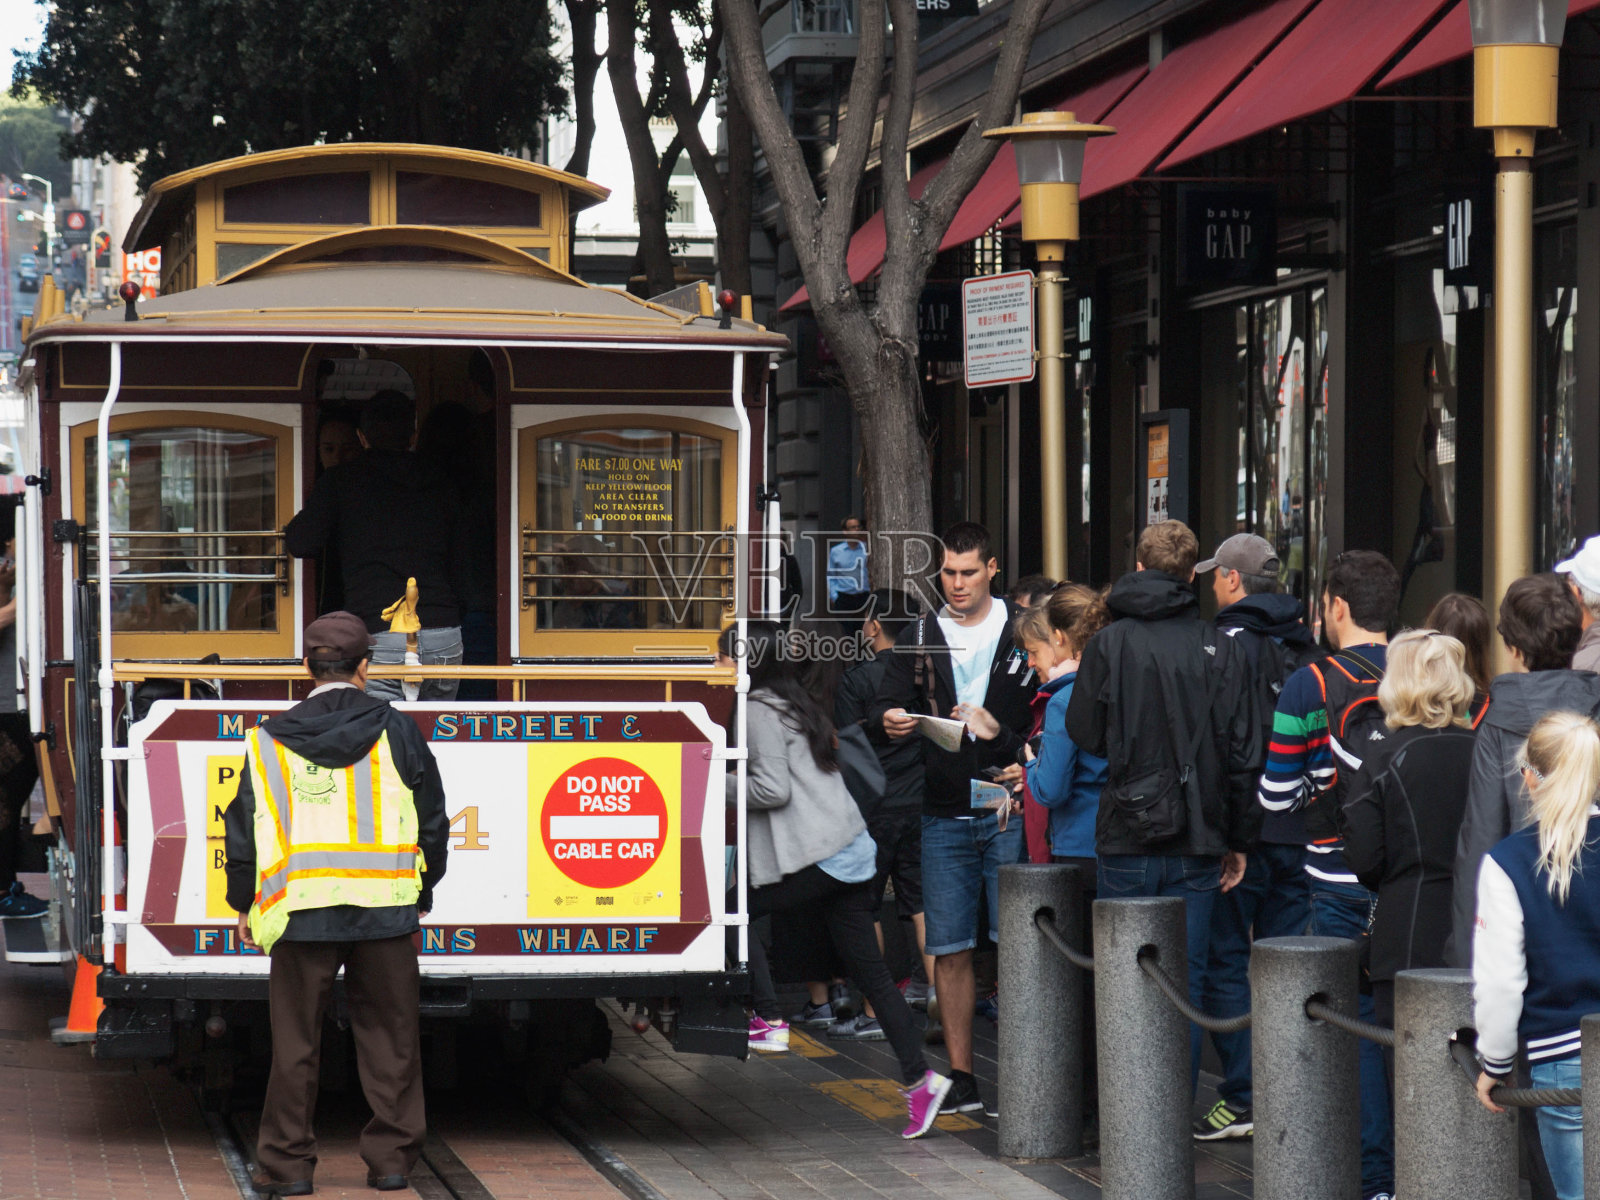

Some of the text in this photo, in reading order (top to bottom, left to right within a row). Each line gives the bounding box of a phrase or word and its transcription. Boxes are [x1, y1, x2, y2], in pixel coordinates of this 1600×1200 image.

[1206, 208, 1252, 221] baby
[1206, 223, 1252, 259] GAP
[1448, 199, 1472, 270] GAP
[575, 458, 684, 471] FARE $7.00 ONE WAY
[608, 473, 650, 481] HOLD ON
[585, 483, 672, 491] KEEP YELLOW FLOOR
[594, 503, 665, 511] NO TRANSFERS
[584, 513, 673, 521] NO FOOD OR DRINK
[433, 714, 602, 740] STREET
[567, 776, 644, 794] DO NOT
[579, 795, 631, 813] PASS
[554, 842, 655, 859] CABLE CAR
[517, 927, 659, 953] WHARF
